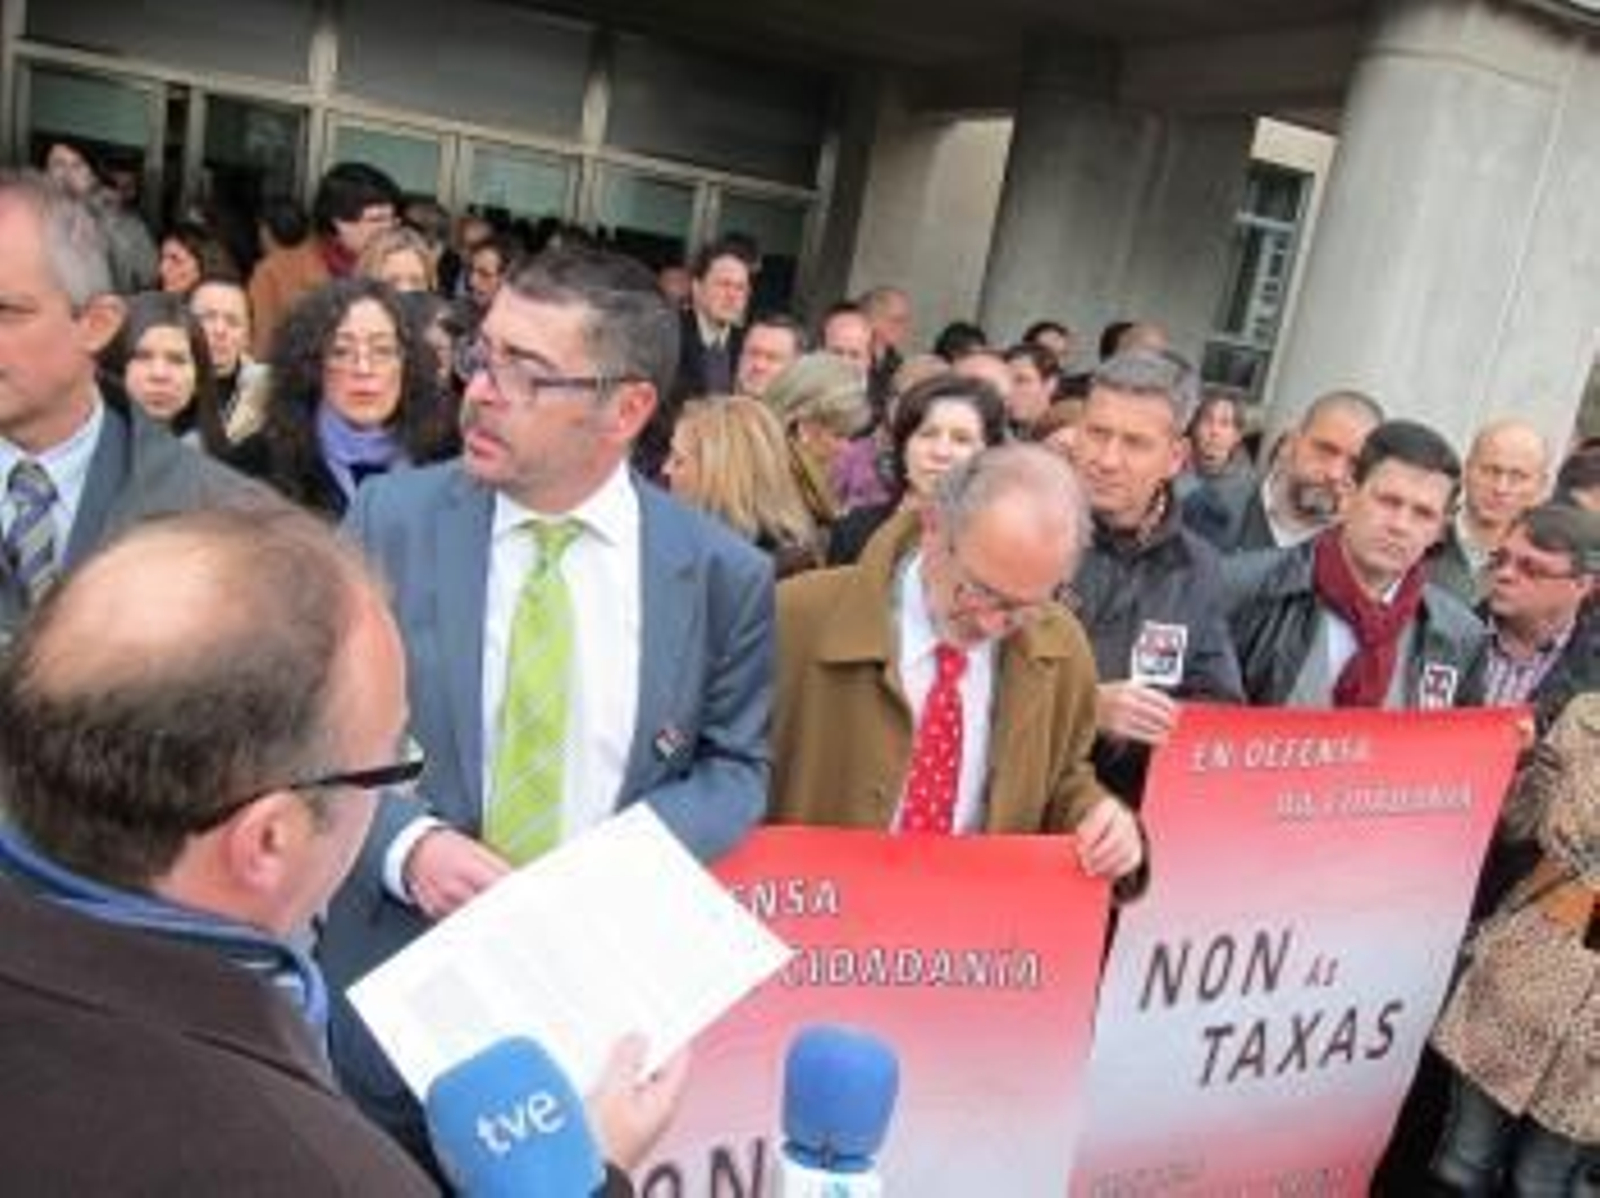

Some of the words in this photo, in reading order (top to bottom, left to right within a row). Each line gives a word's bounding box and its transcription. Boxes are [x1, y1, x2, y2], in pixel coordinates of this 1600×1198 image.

[1139, 929, 1291, 1011] NON
[1200, 1000, 1404, 1086] TAXAS
[477, 1090, 566, 1153] tve
